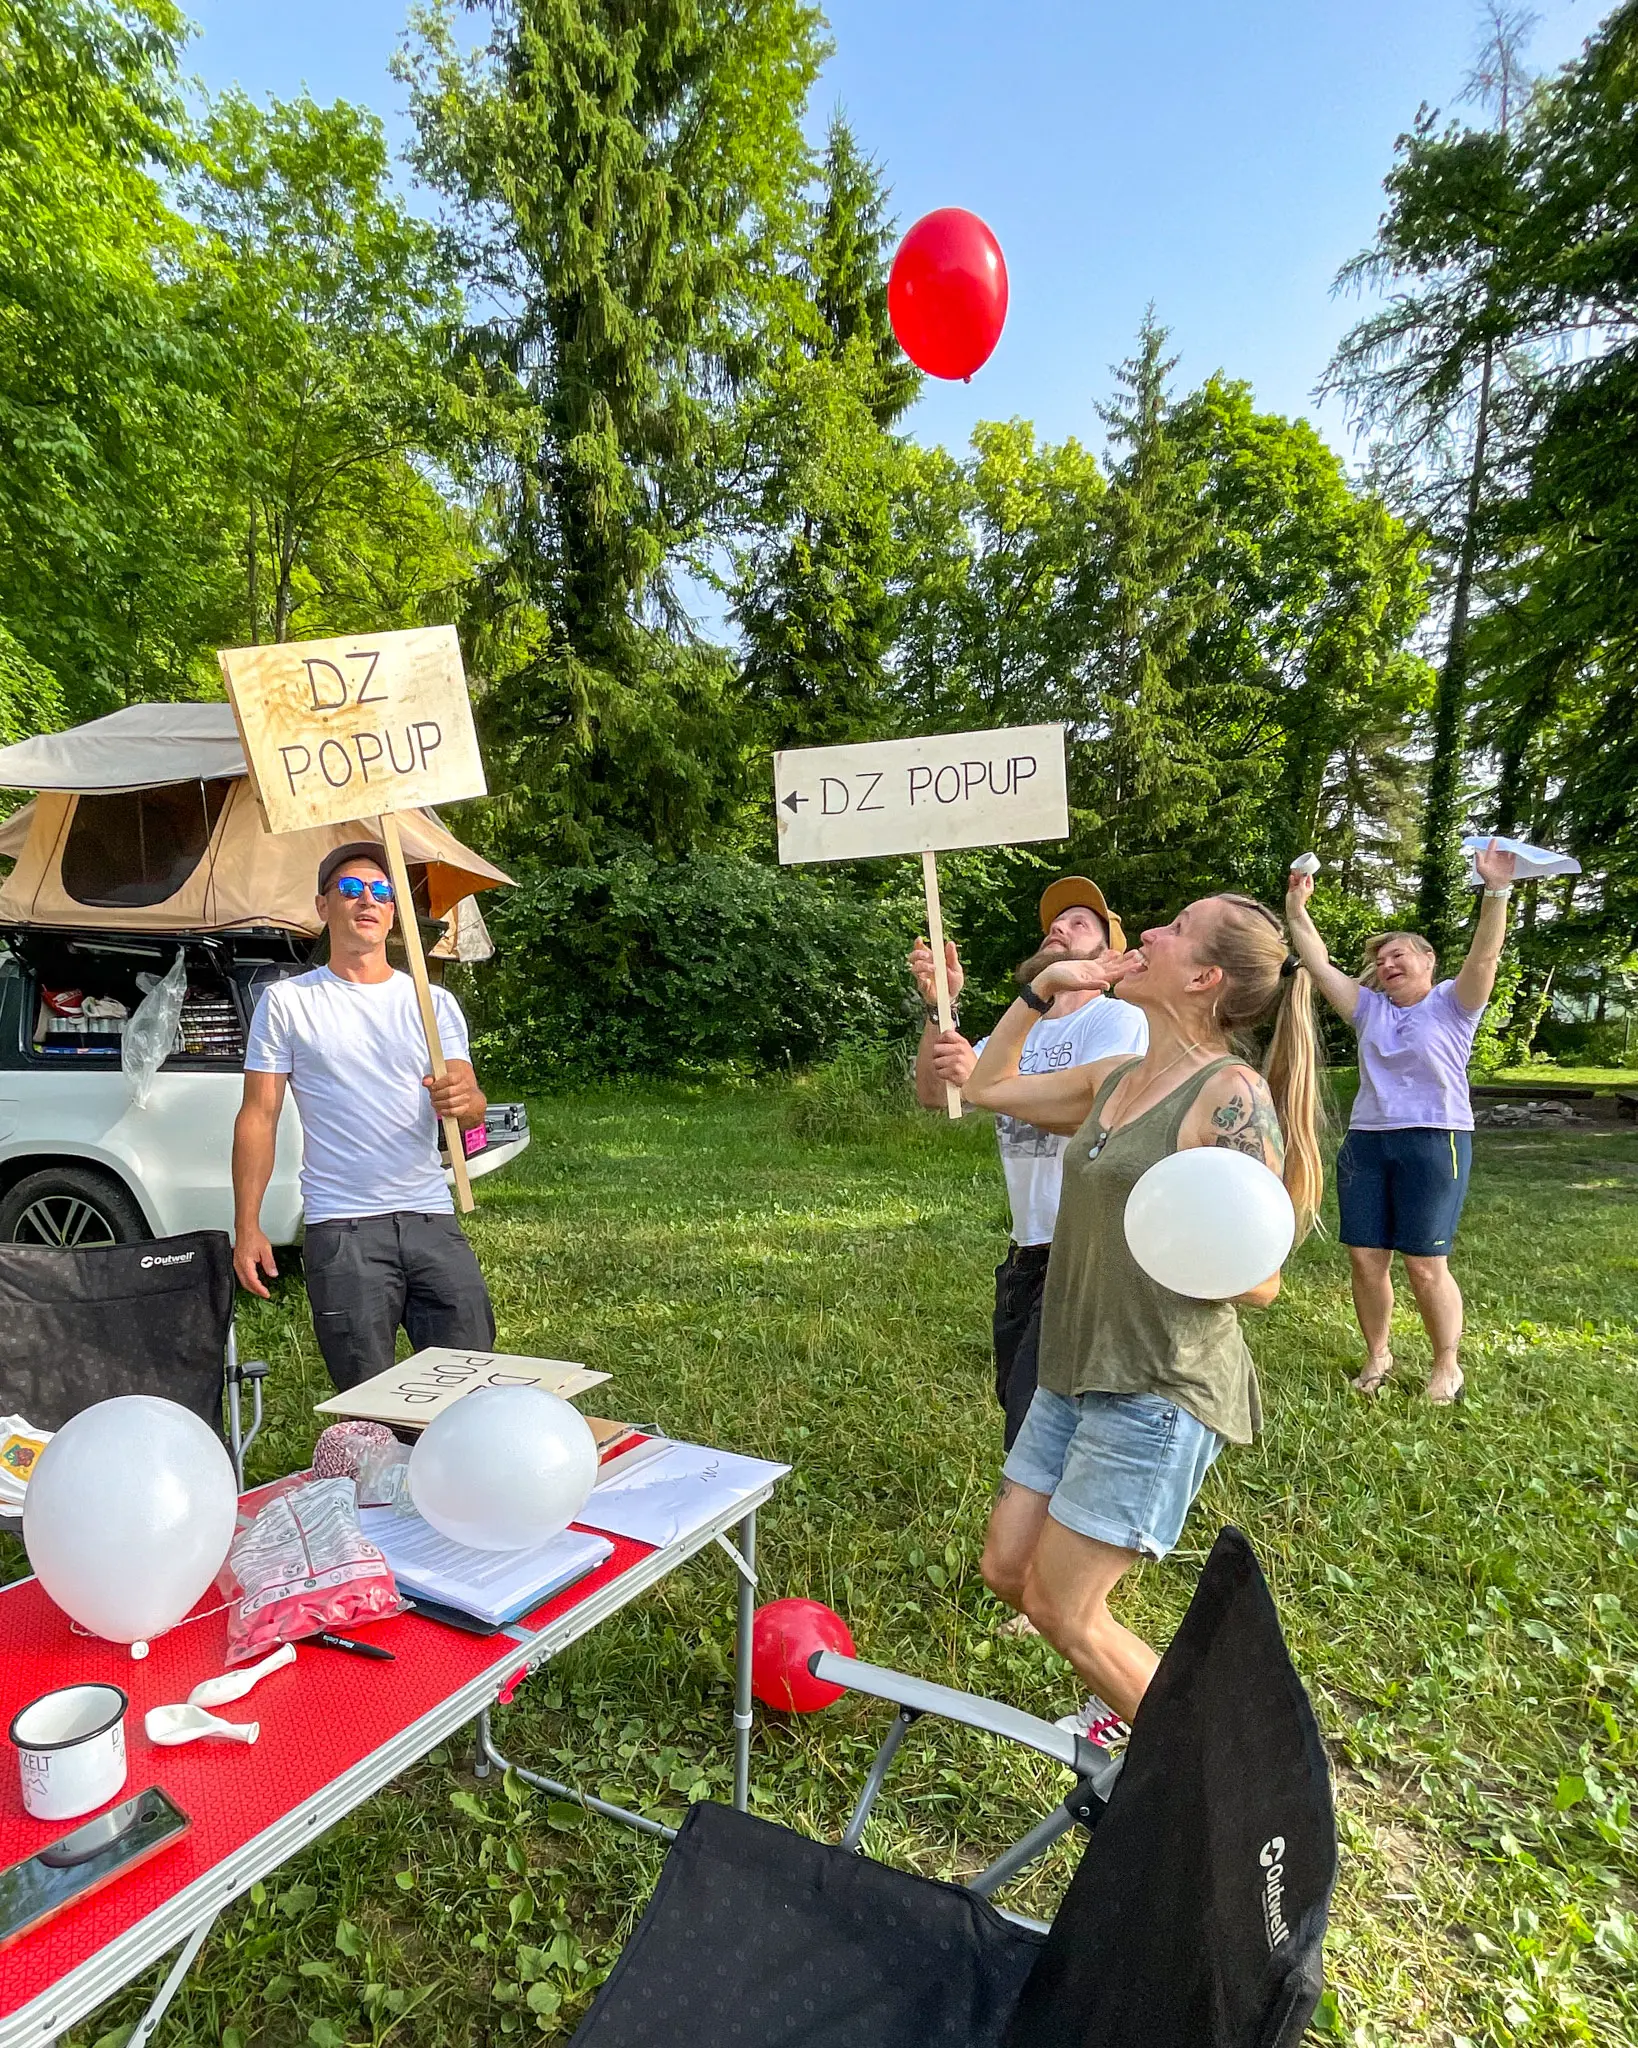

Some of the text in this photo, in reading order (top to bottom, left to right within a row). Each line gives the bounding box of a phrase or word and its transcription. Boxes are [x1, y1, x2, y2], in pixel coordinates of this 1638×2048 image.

[301, 651, 389, 711] DZ
[278, 721, 442, 797] POPUP
[819, 756, 1037, 815] DZ POPUP
[153, 1252, 194, 1265] Outwell
[390, 1354, 495, 1404] POPUP
[1266, 1863, 1289, 1947] Outwell
